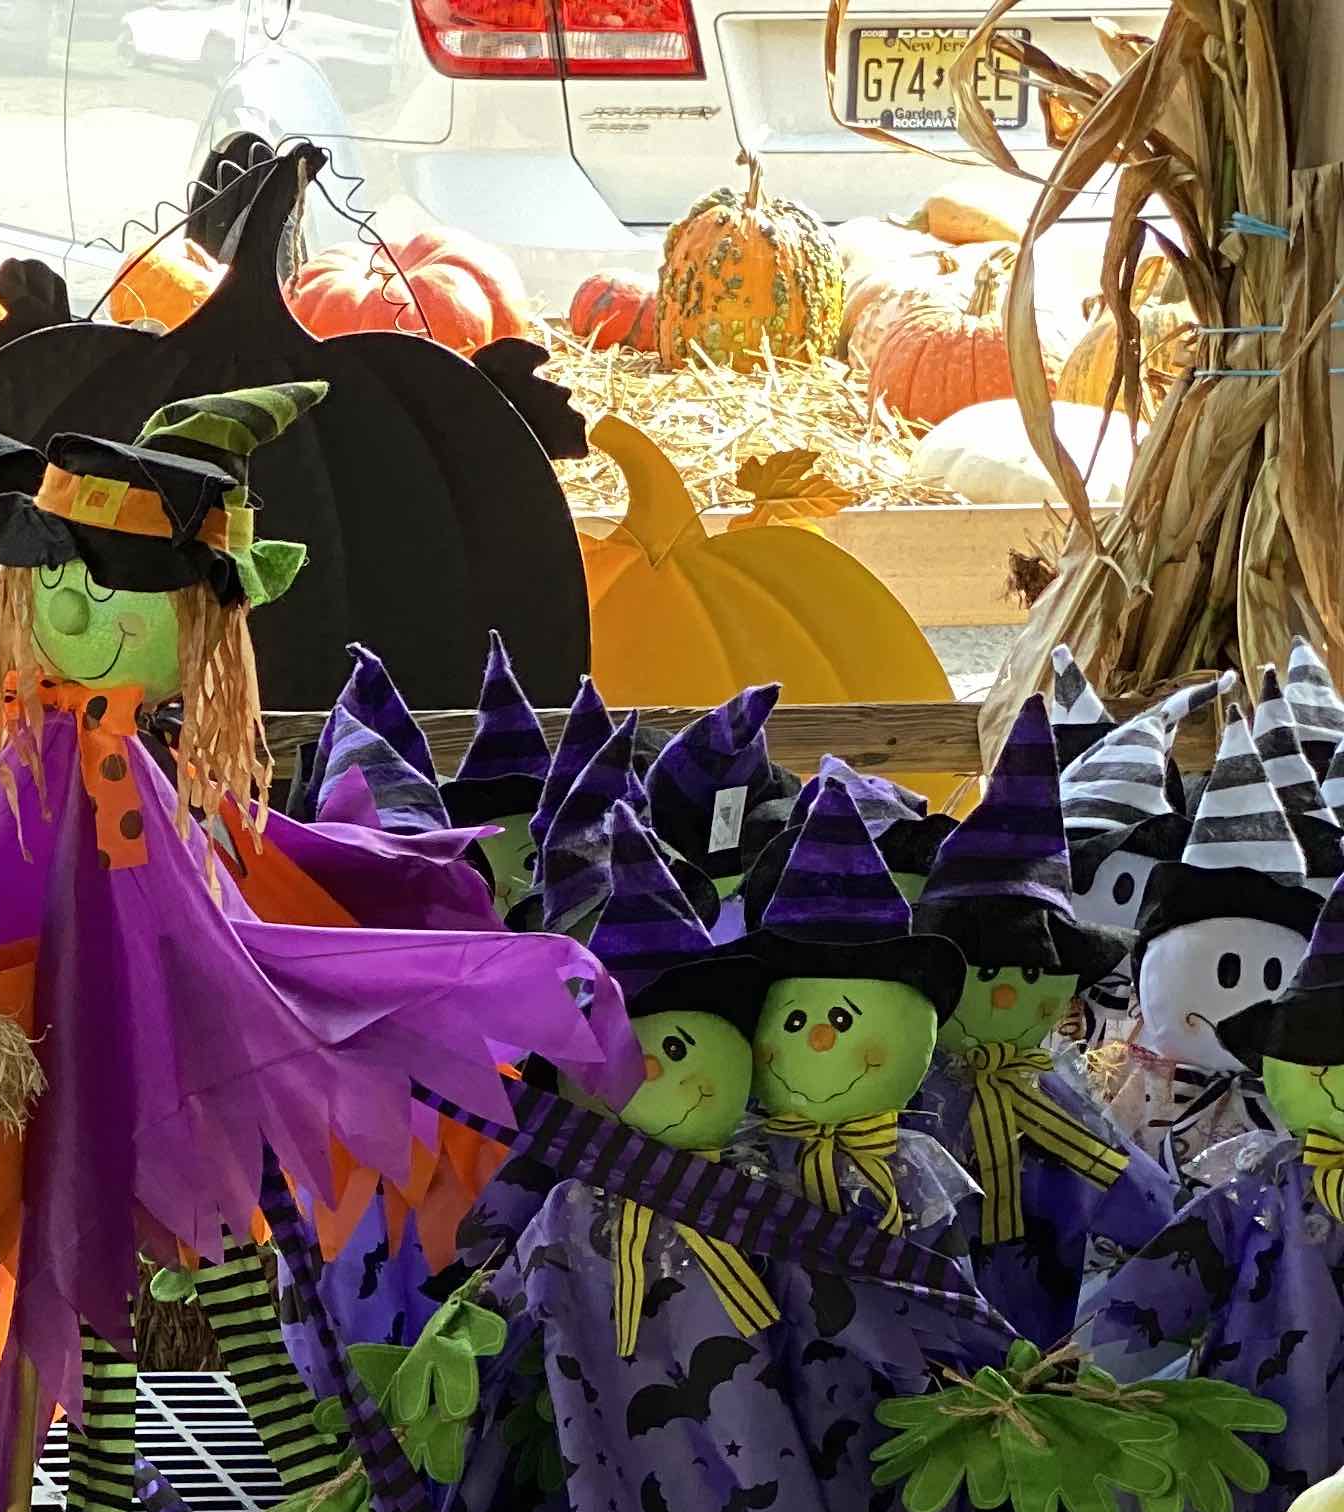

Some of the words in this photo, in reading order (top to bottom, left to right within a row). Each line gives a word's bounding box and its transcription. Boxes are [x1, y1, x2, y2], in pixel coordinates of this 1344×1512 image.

[897, 38, 934, 52] New
[863, 57, 925, 102] G74
[895, 107, 942, 120] Garden
